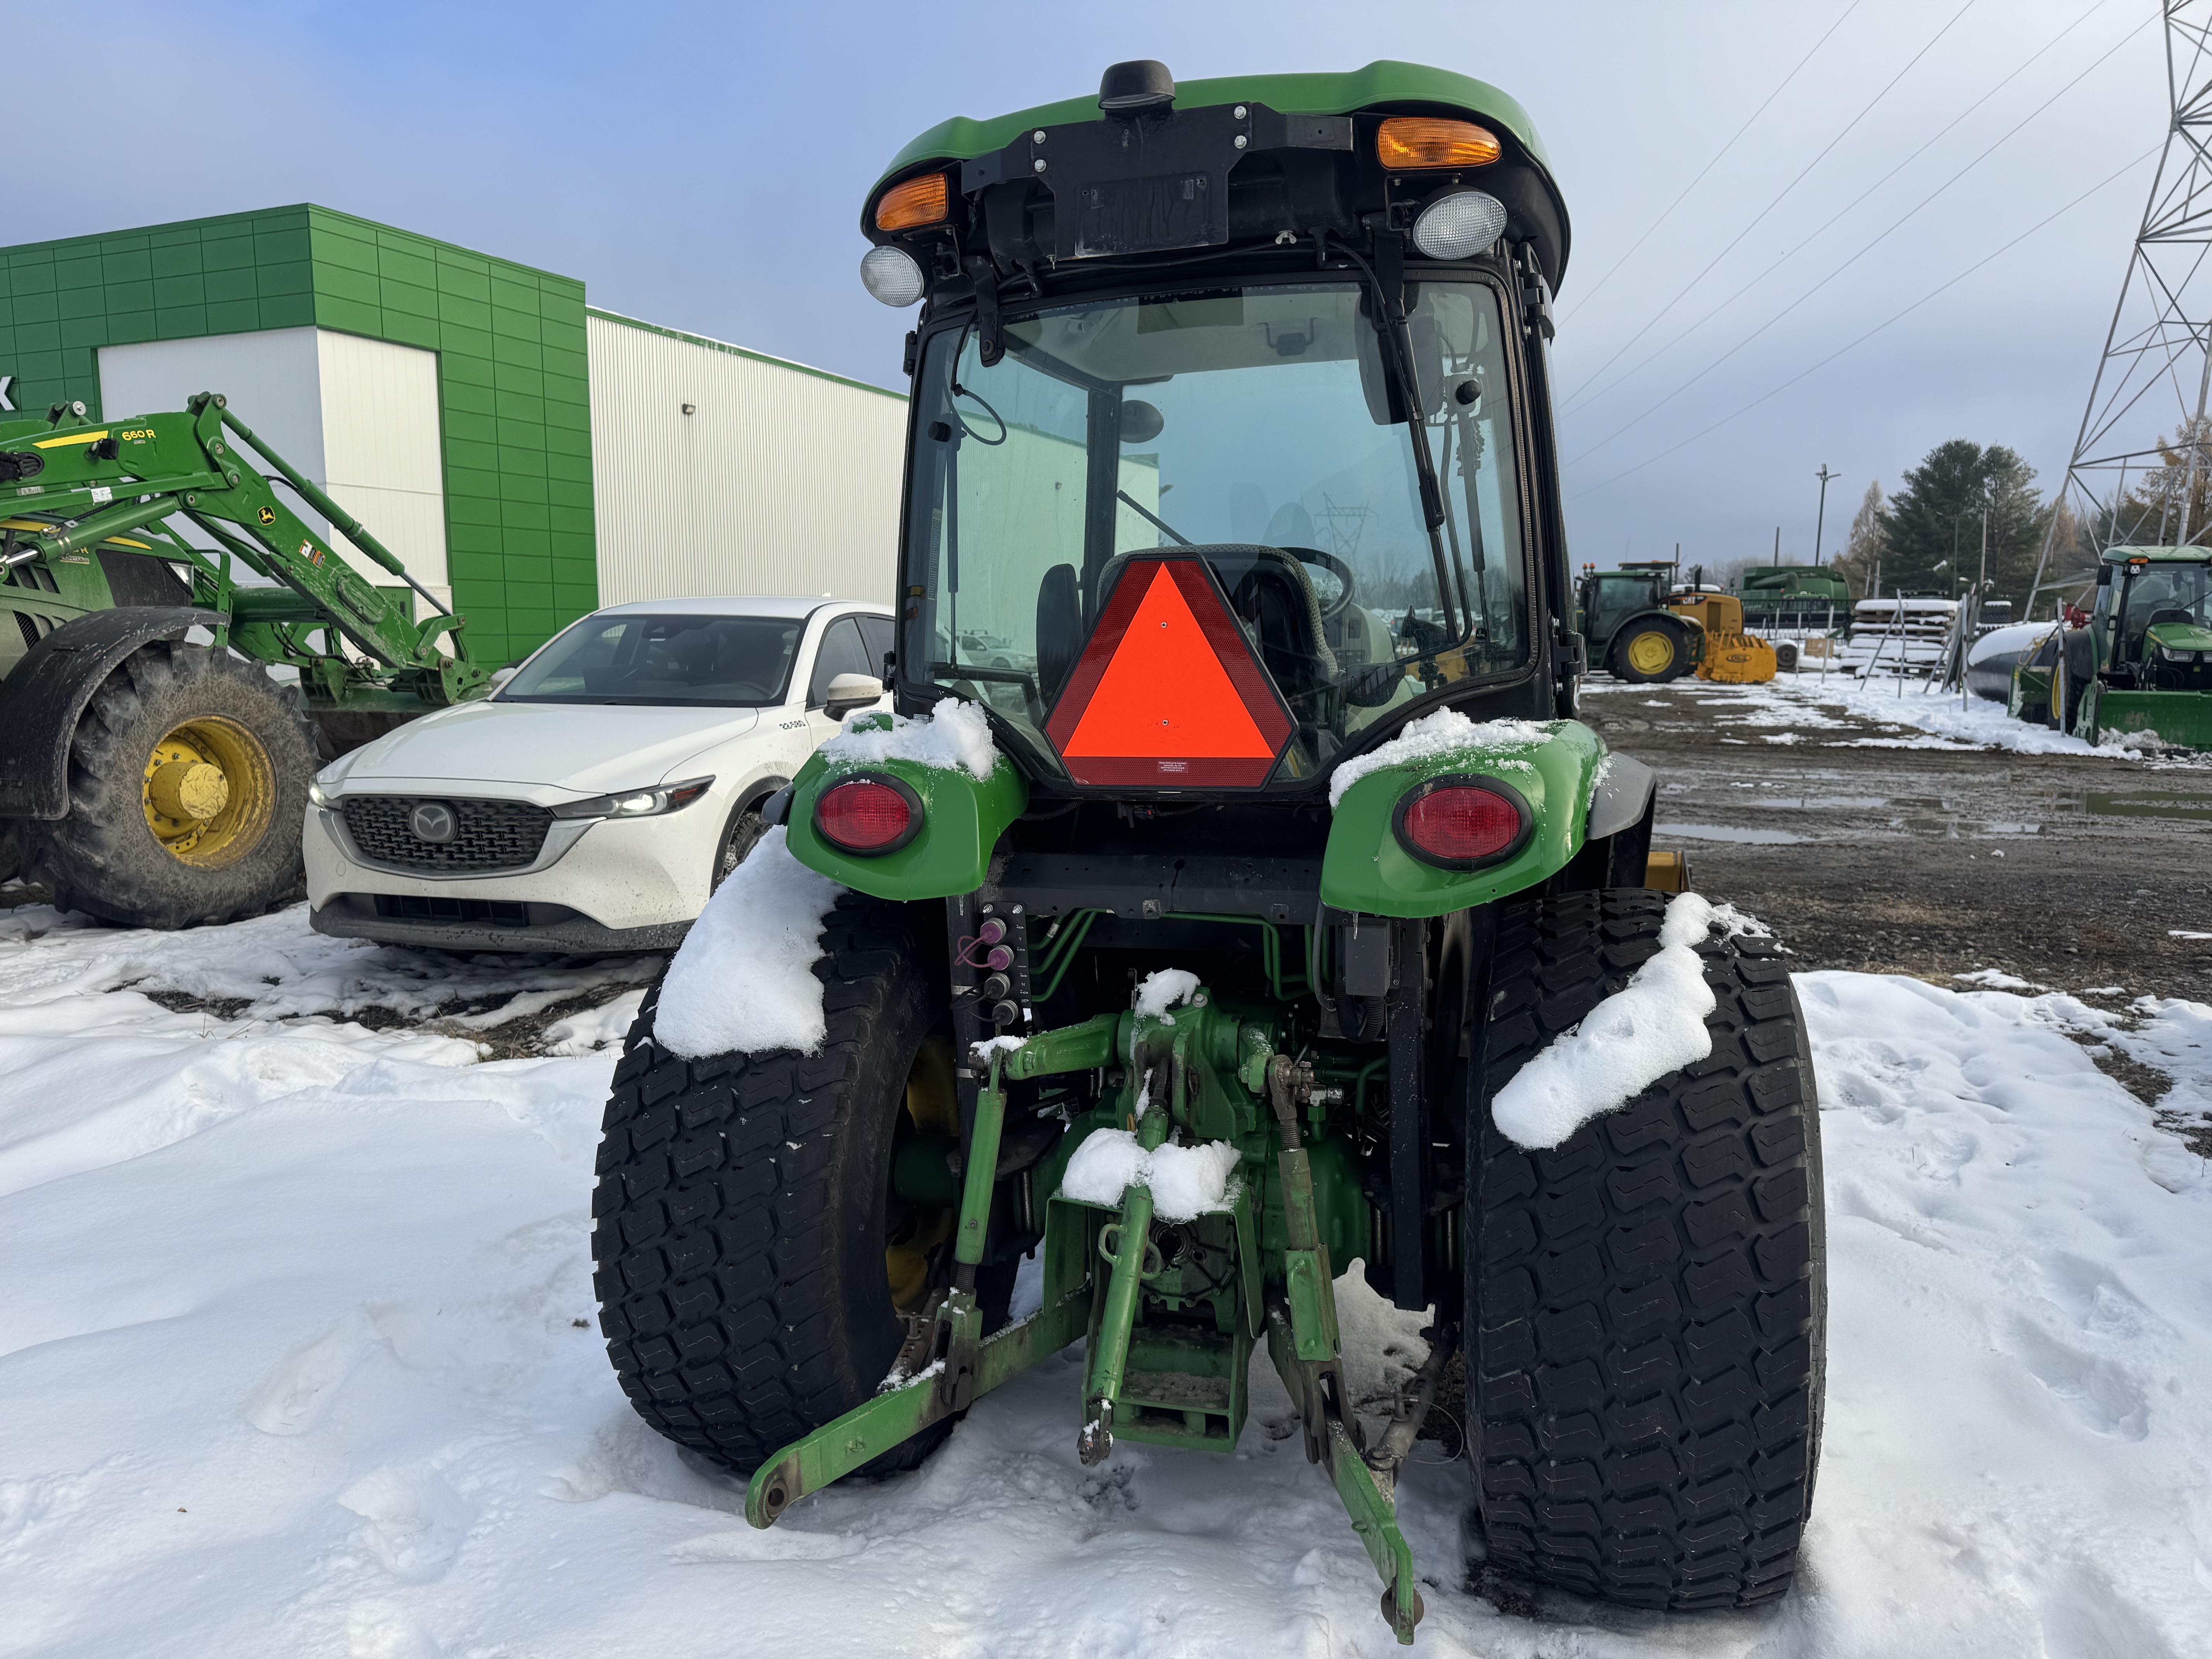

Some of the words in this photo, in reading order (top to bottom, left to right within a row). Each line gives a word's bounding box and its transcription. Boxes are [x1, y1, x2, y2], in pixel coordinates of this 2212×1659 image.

[122, 430, 145, 441] 660
[146, 429, 156, 438] R
[1683, 596, 1696, 605] CAT
